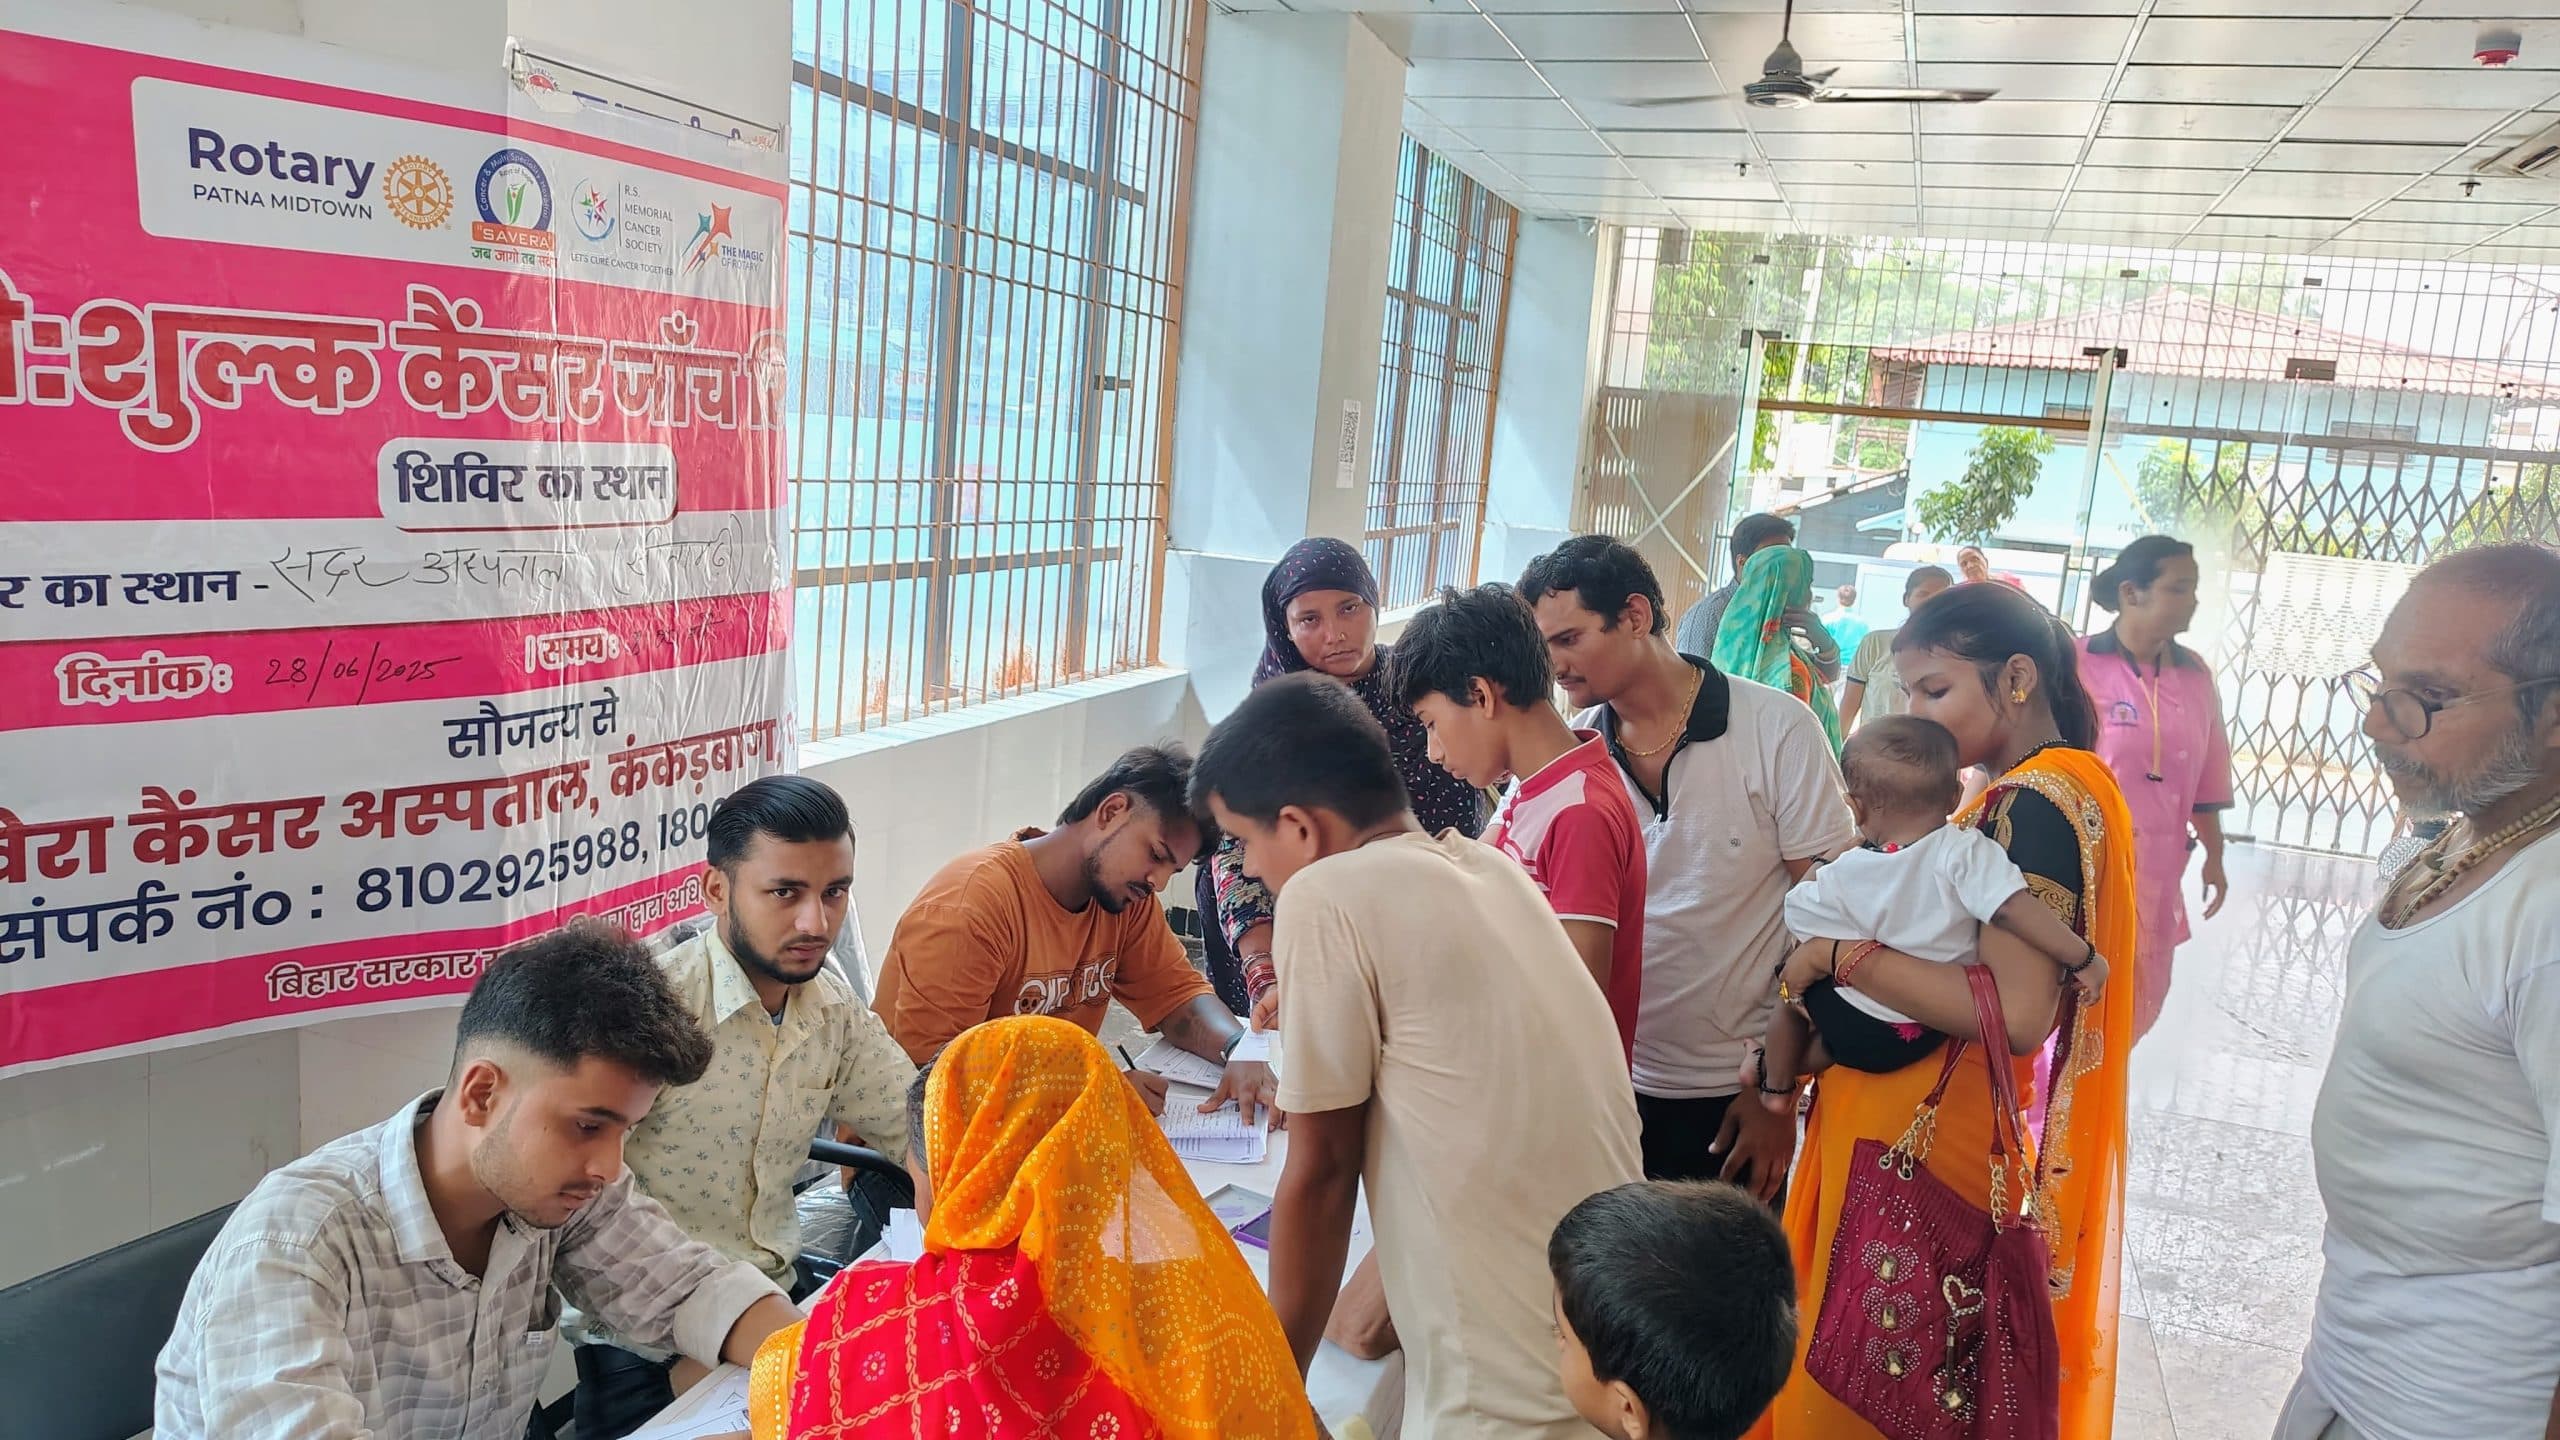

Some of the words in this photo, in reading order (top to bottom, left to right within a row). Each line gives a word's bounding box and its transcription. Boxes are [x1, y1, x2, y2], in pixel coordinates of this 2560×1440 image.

[188, 127, 375, 200] Rotary
[193, 184, 265, 208] PATNA
[271, 193, 373, 220] MIDTOWN
[479, 178, 489, 212] Cancer
[624, 184, 640, 198] R.S.
[624, 204, 673, 222] MEMORIAL
[624, 221, 662, 237] CANCER
[471, 246, 492, 260] जब
[494, 247, 519, 264] जागो
[521, 252, 536, 266] तब
[625, 238, 664, 255] SOCIETY
[721, 245, 737, 258] THE
[738, 248, 765, 262] MAGIC
[590, 255, 609, 267] CURE
[611, 259, 640, 271] CANCER
[640, 263, 674, 276] TOGETHER
[721, 257, 731, 269] OF
[731, 259, 760, 273] ROTARY
[391, 284, 607, 424] कैंसर
[608, 310, 741, 428] जाँच
[392, 450, 528, 503] शिविर
[535, 463, 586, 501] का
[591, 463, 669, 501] स्थान
[41, 573, 112, 608] का
[121, 570, 241, 605] स्थान
[265, 639, 463, 706] 28/06/2025
[442, 700, 584, 759] सौजन्य
[590, 687, 620, 734] से
[0, 807, 114, 884] वेरा
[128, 786, 326, 866] कैंसर
[339, 760, 599, 840] अस्पताल,
[0, 879, 181, 963] संपर्क
[356, 819, 648, 912] 8102925988,
[265, 961, 359, 1001] बिहार
[360, 949, 476, 985] सरकार
